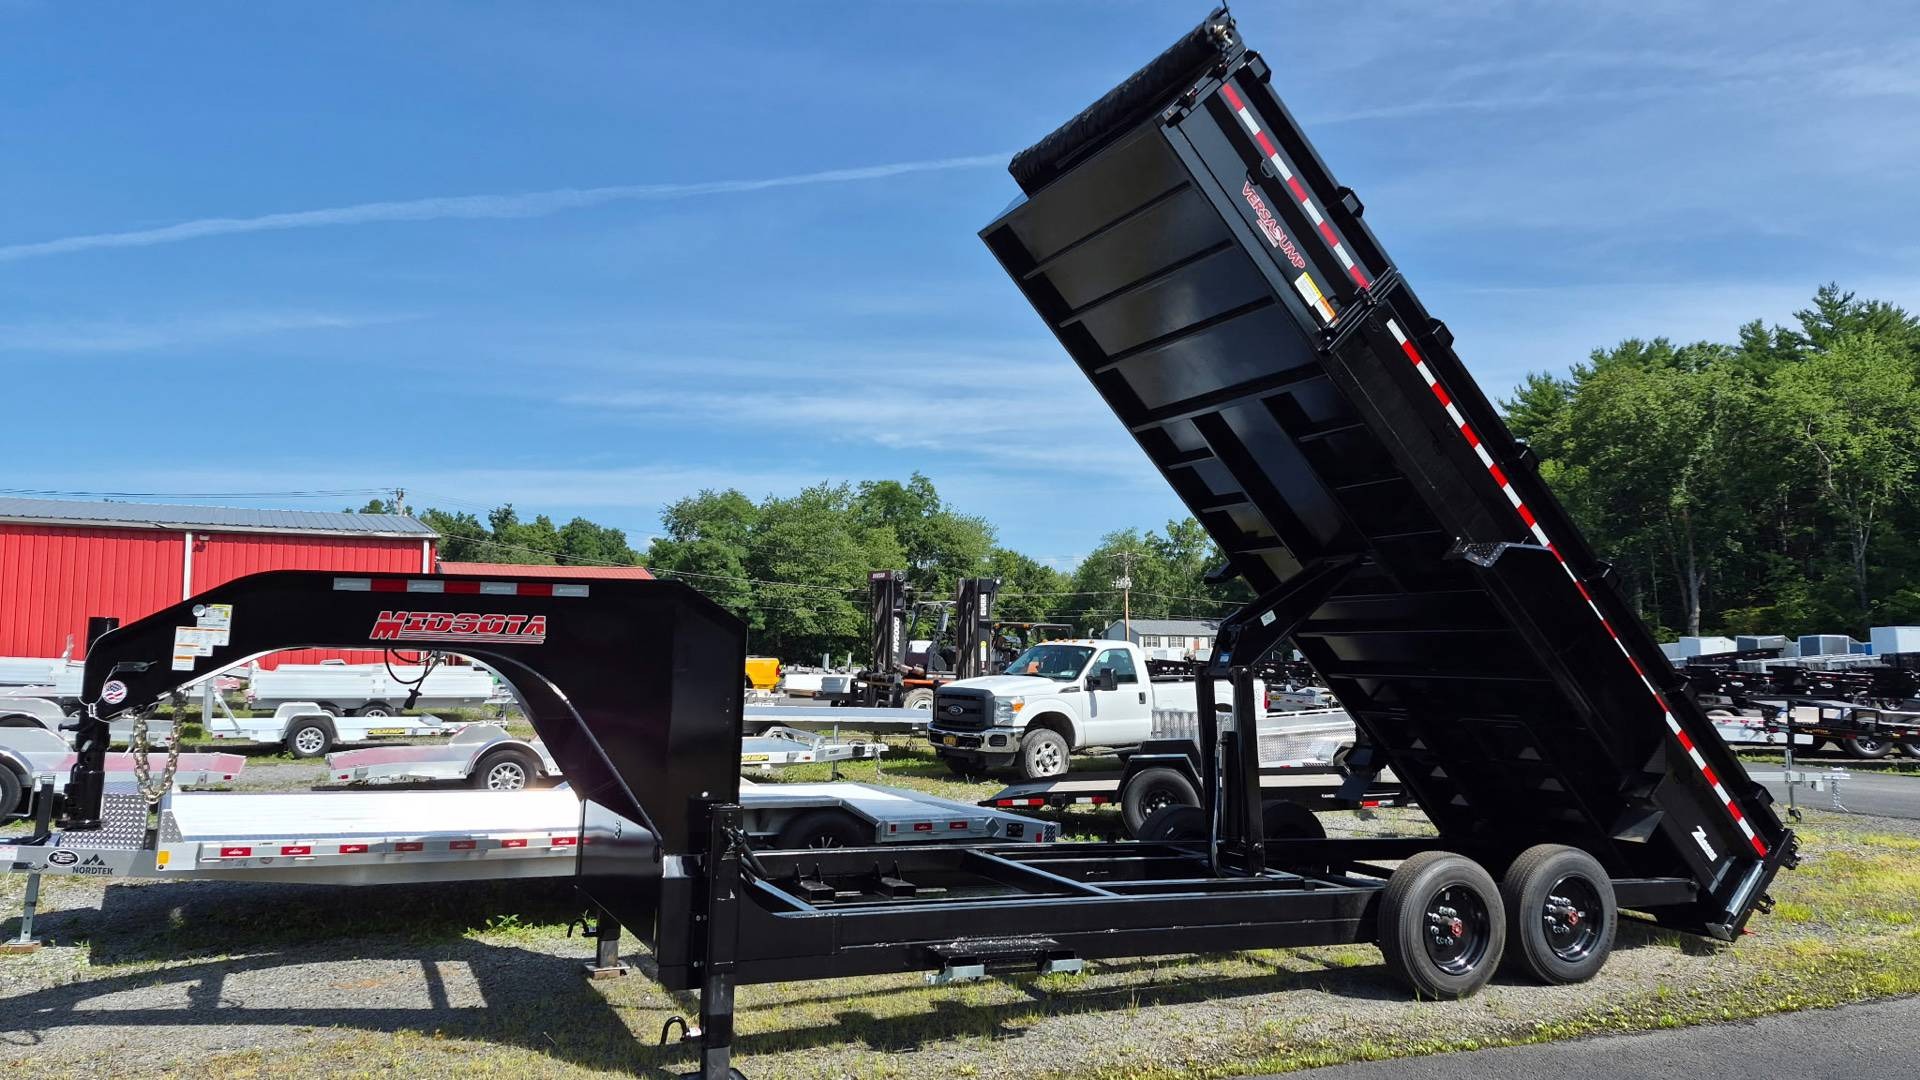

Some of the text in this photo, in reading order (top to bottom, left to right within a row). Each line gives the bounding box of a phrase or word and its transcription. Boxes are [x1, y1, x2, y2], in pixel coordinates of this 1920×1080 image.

[1242, 180, 1306, 269] VERSADUMP
[369, 611, 546, 640] MIDSOTA
[892, 616, 900, 653] DOOSAN
[72, 866, 114, 875] NORDTEK
